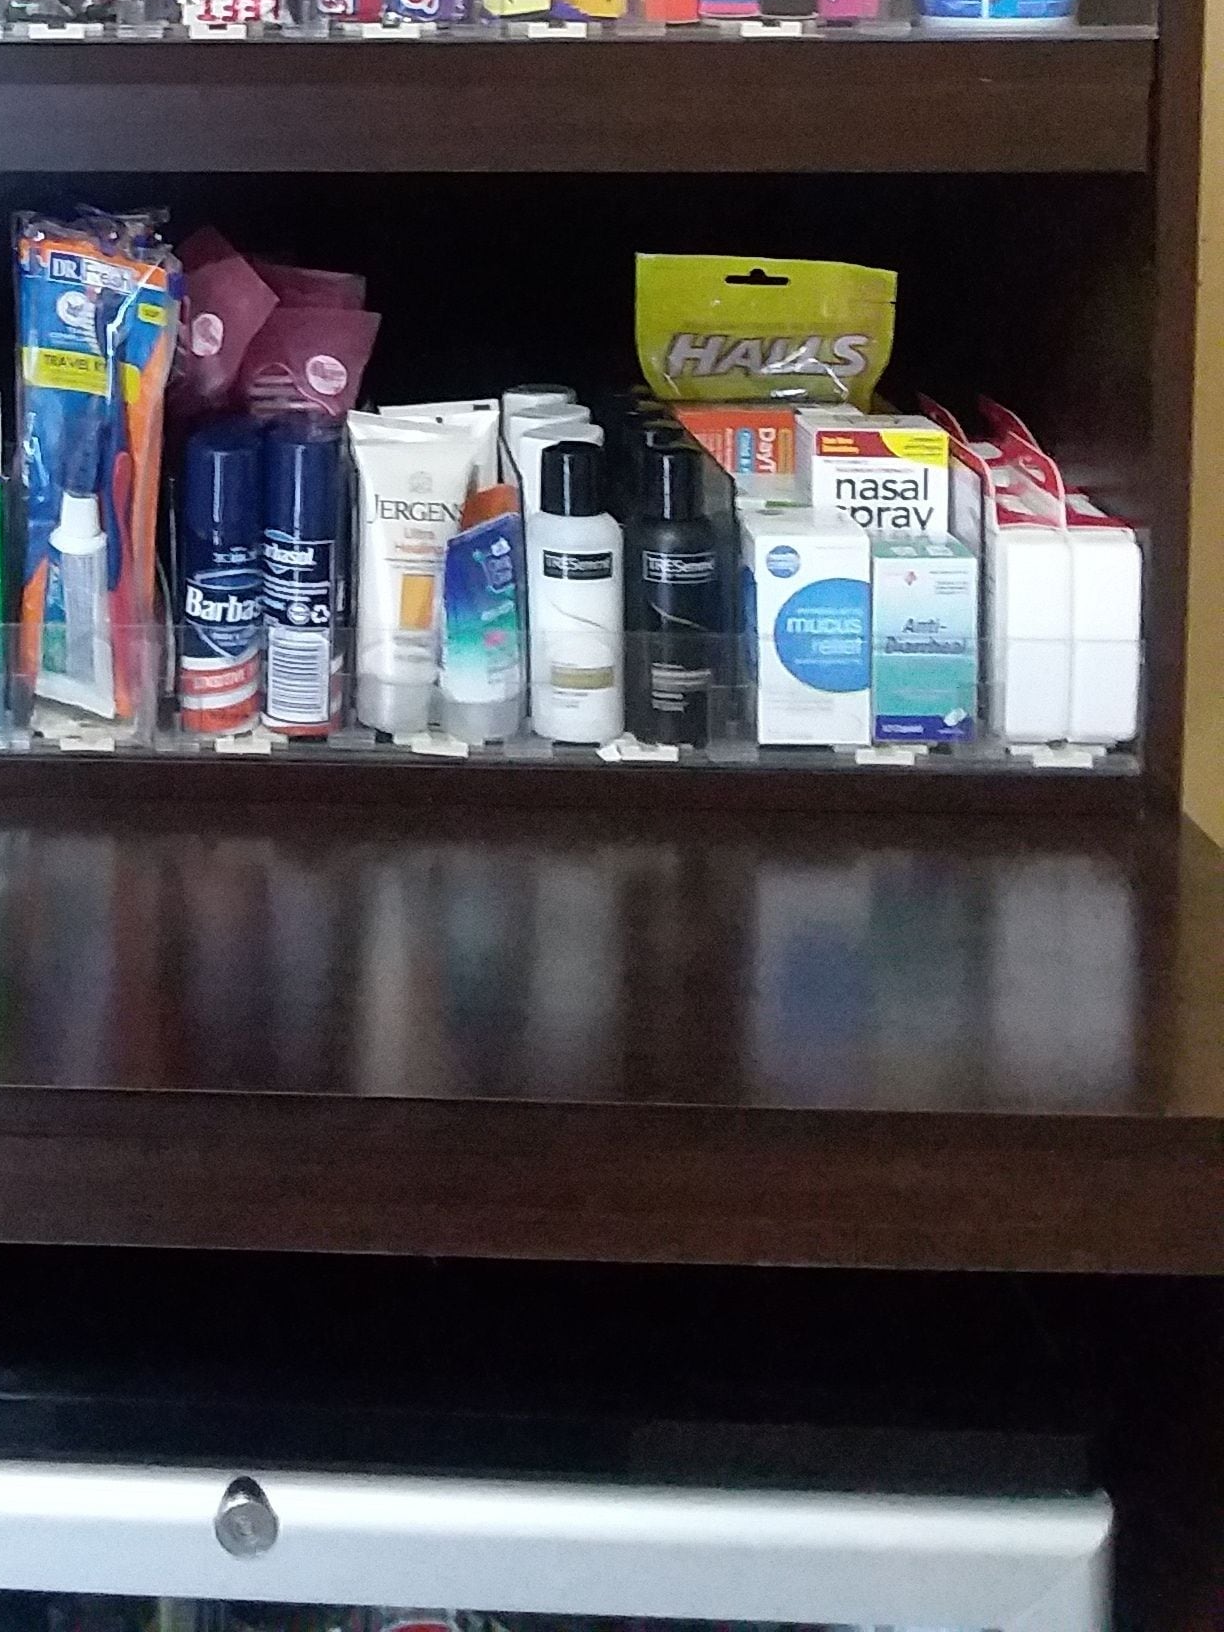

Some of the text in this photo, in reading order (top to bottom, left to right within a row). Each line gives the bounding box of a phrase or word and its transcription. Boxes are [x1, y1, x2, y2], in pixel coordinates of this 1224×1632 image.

[668, 332, 871, 378] HALLS
[836, 467, 929, 501] nasal
[836, 505, 935, 530] pray
[785, 618, 863, 634] mucus
